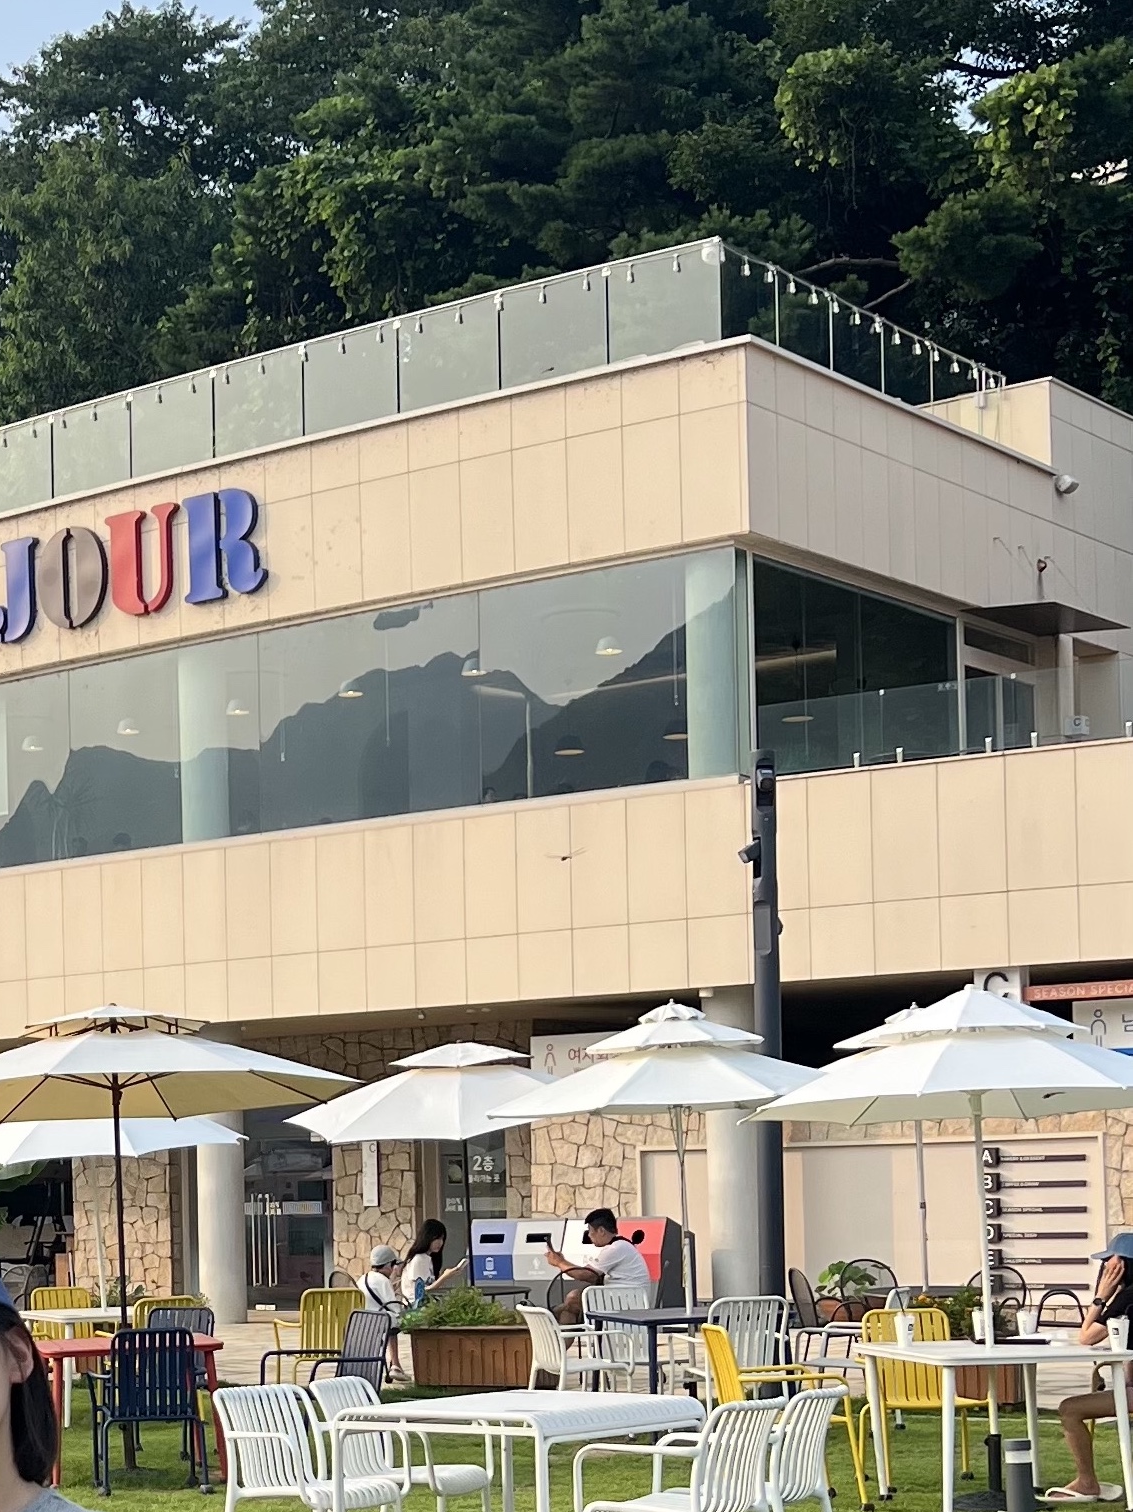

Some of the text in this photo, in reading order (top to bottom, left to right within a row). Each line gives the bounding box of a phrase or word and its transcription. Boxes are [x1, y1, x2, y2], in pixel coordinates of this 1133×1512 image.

[1034, 986, 1086, 999] SEASON
[472, 1155, 495, 1171] 2층
[982, 1150, 993, 1163] A
